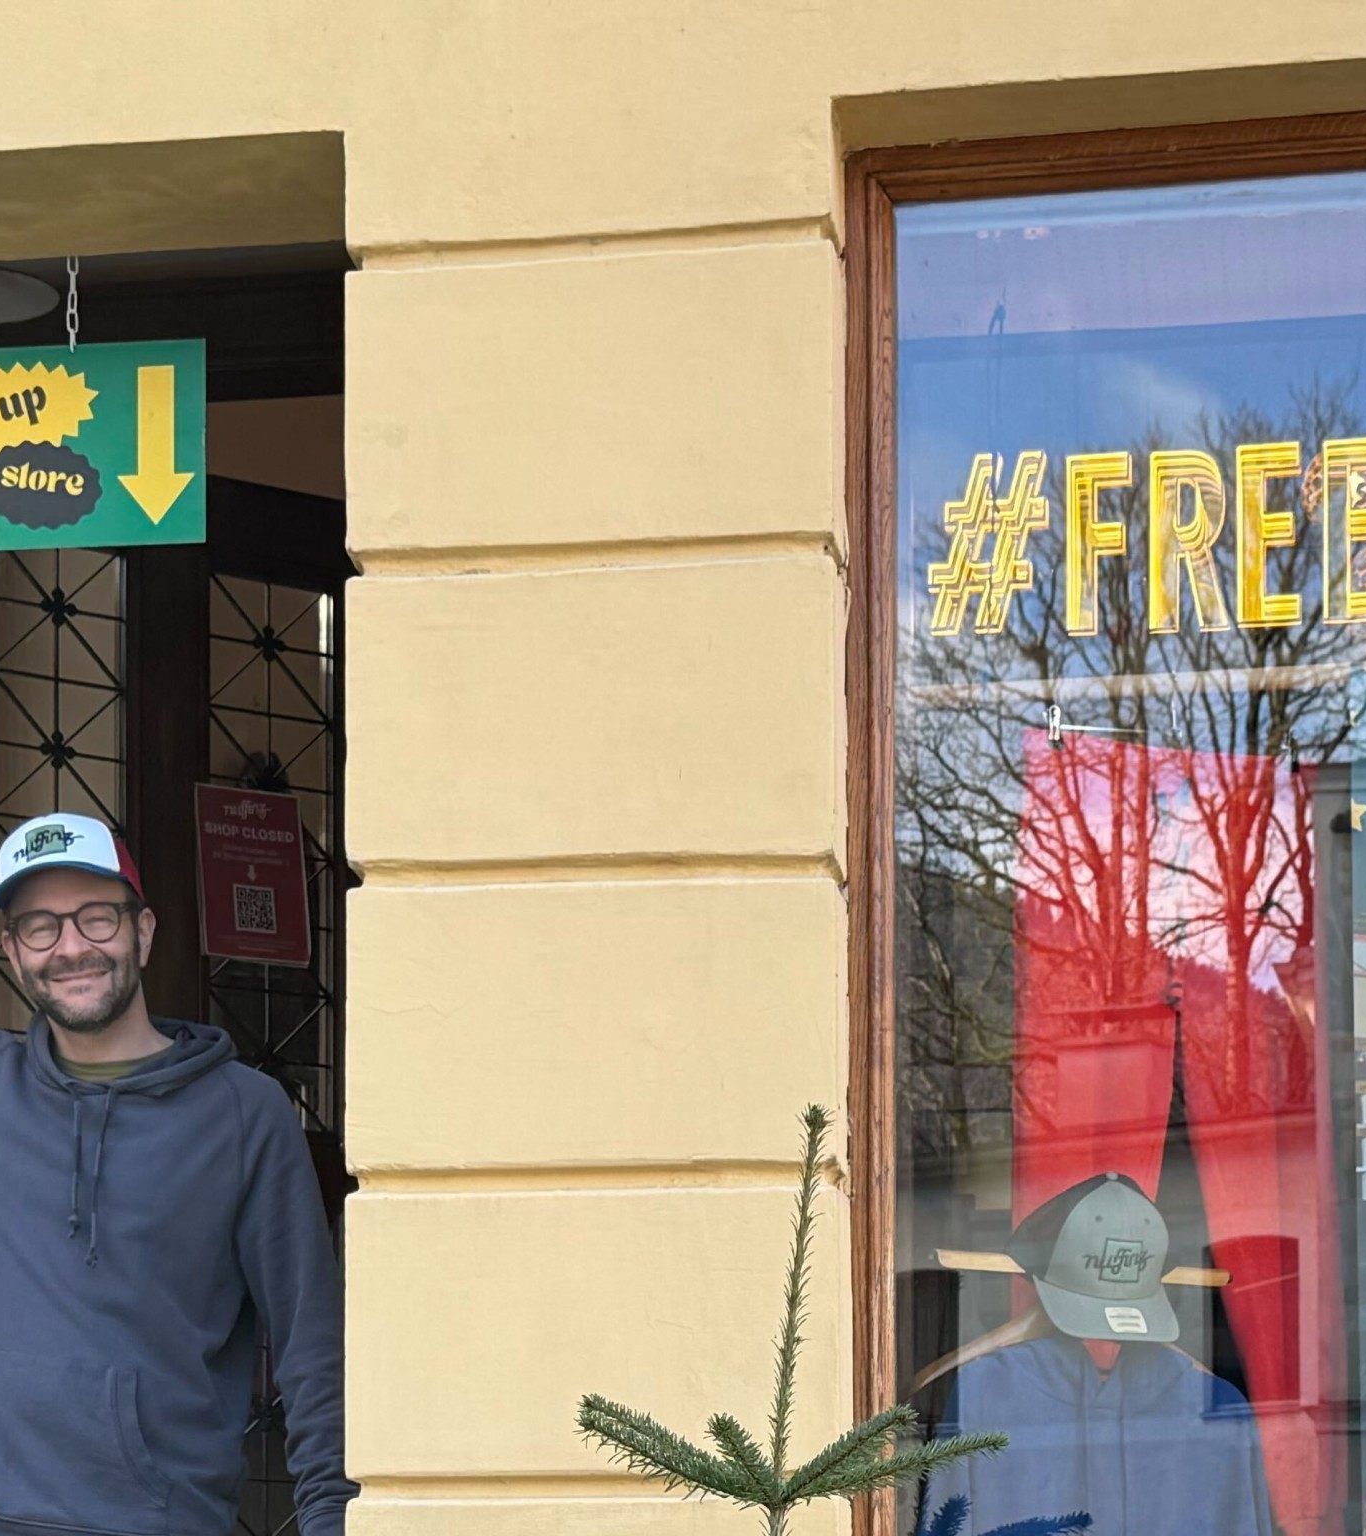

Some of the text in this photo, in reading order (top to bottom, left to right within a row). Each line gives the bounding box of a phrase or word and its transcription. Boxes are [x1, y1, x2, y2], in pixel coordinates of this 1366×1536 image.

[0, 461, 85, 496] store
[13, 830, 85, 862] nuffinz
[204, 821, 295, 843] SHOP CLOSED
[1083, 1247, 1154, 1275] nuffinz
